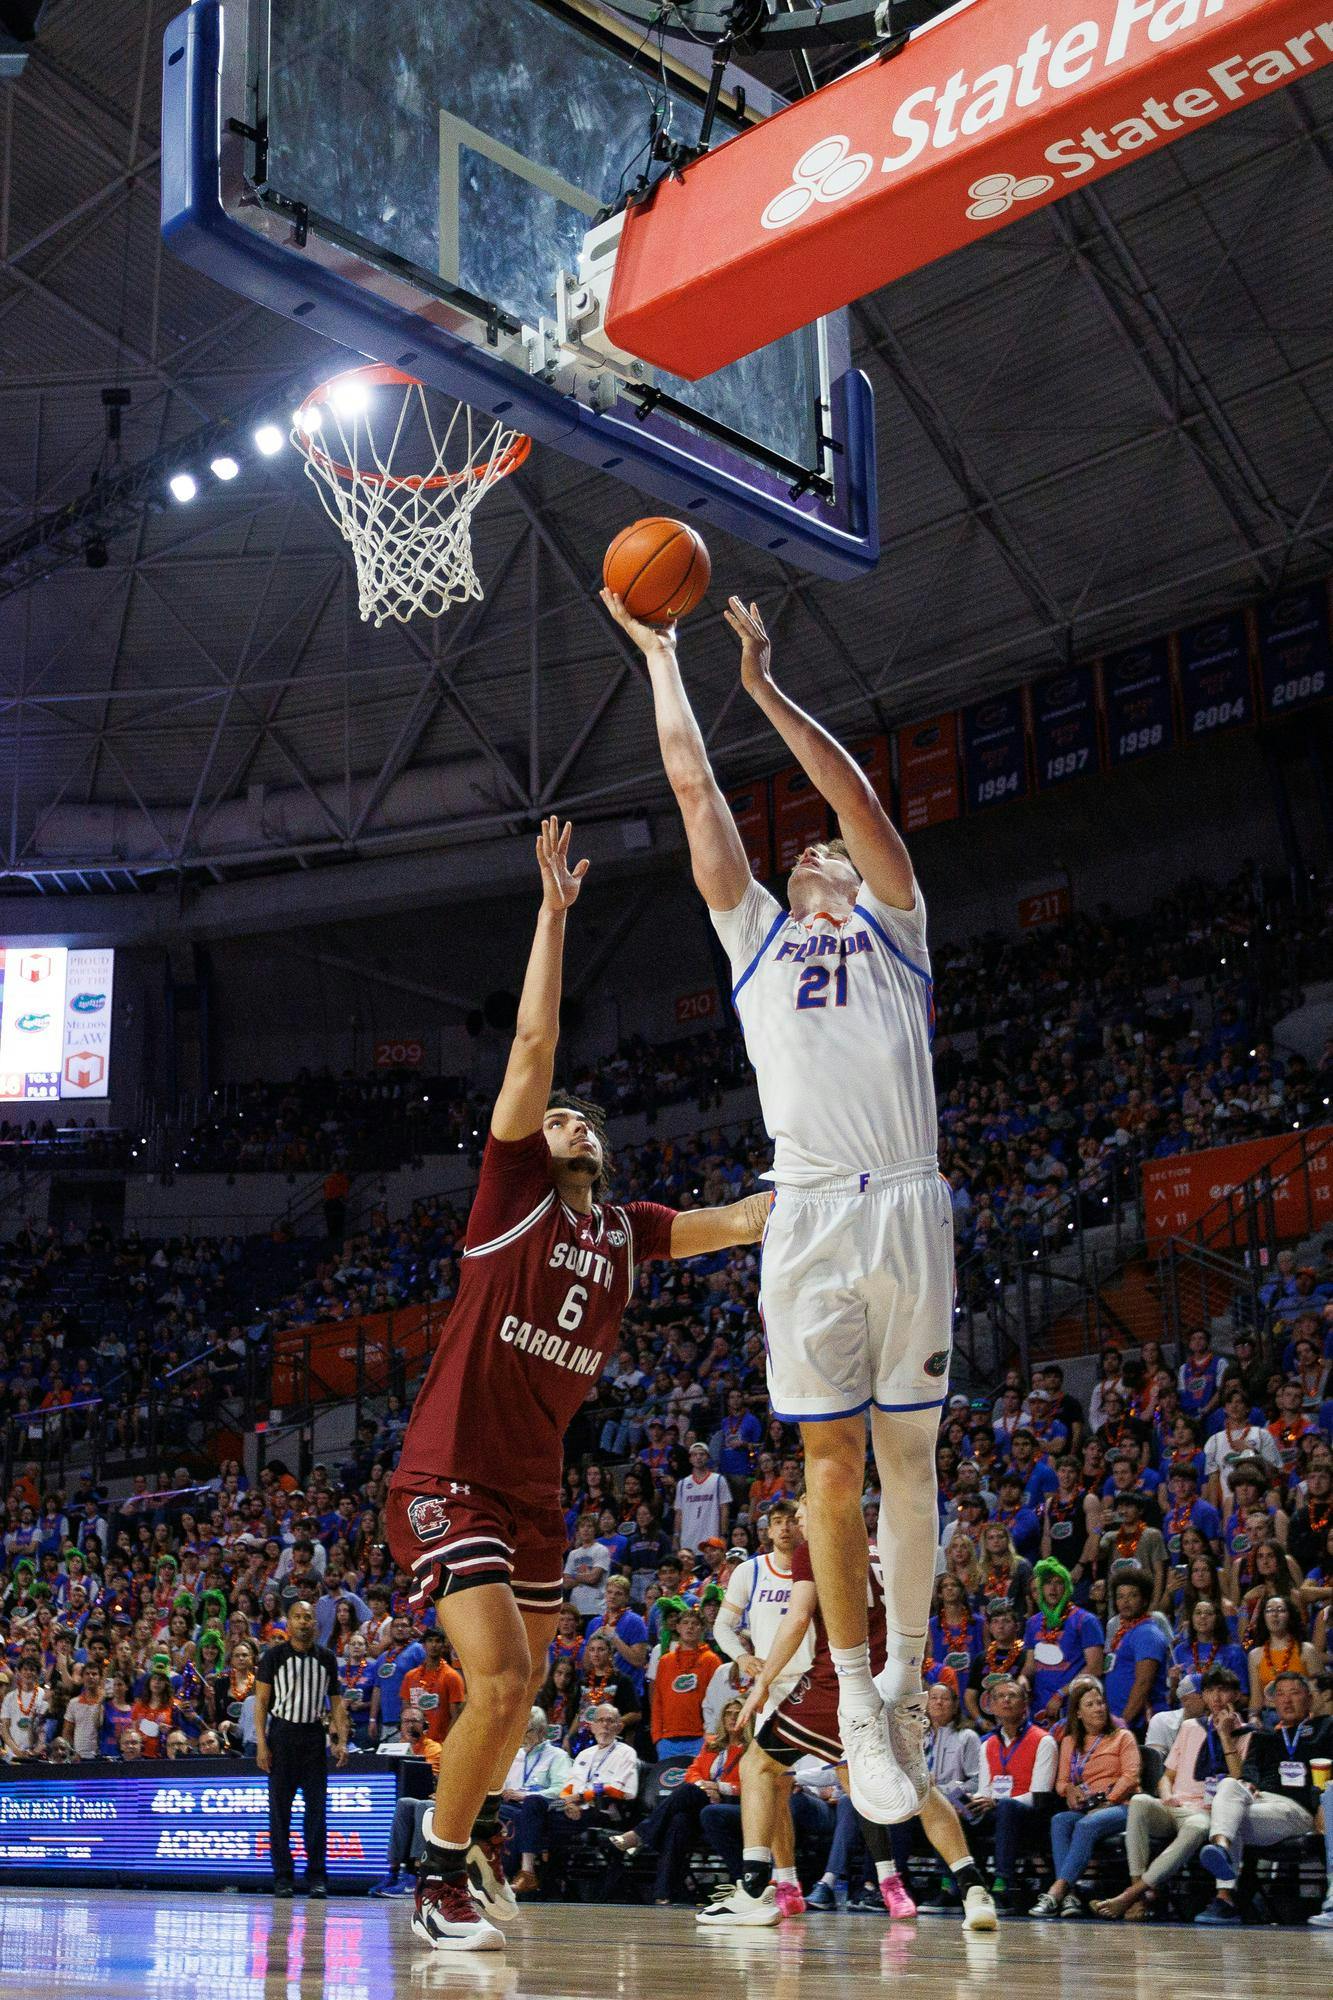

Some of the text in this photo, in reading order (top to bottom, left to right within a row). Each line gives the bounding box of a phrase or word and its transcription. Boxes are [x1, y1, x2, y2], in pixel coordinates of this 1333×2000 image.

[1192, 695, 1245, 733] 2004
[1046, 746, 1089, 781] 1997
[978, 770, 1018, 803] 1994
[1029, 895, 1059, 922] 211
[70, 956, 109, 967] PROUD
[796, 965, 848, 1009] 21
[679, 994, 710, 1020] 210
[376, 1043, 422, 1064] 209
[859, 1173, 871, 1194] F
[606, 1230, 626, 1247] SEC
[549, 1243, 614, 1293] SOUTH
[557, 1283, 589, 1332] 6
[500, 1315, 603, 1376] CAROLINA
[154, 1830, 251, 1858] ACROSS
